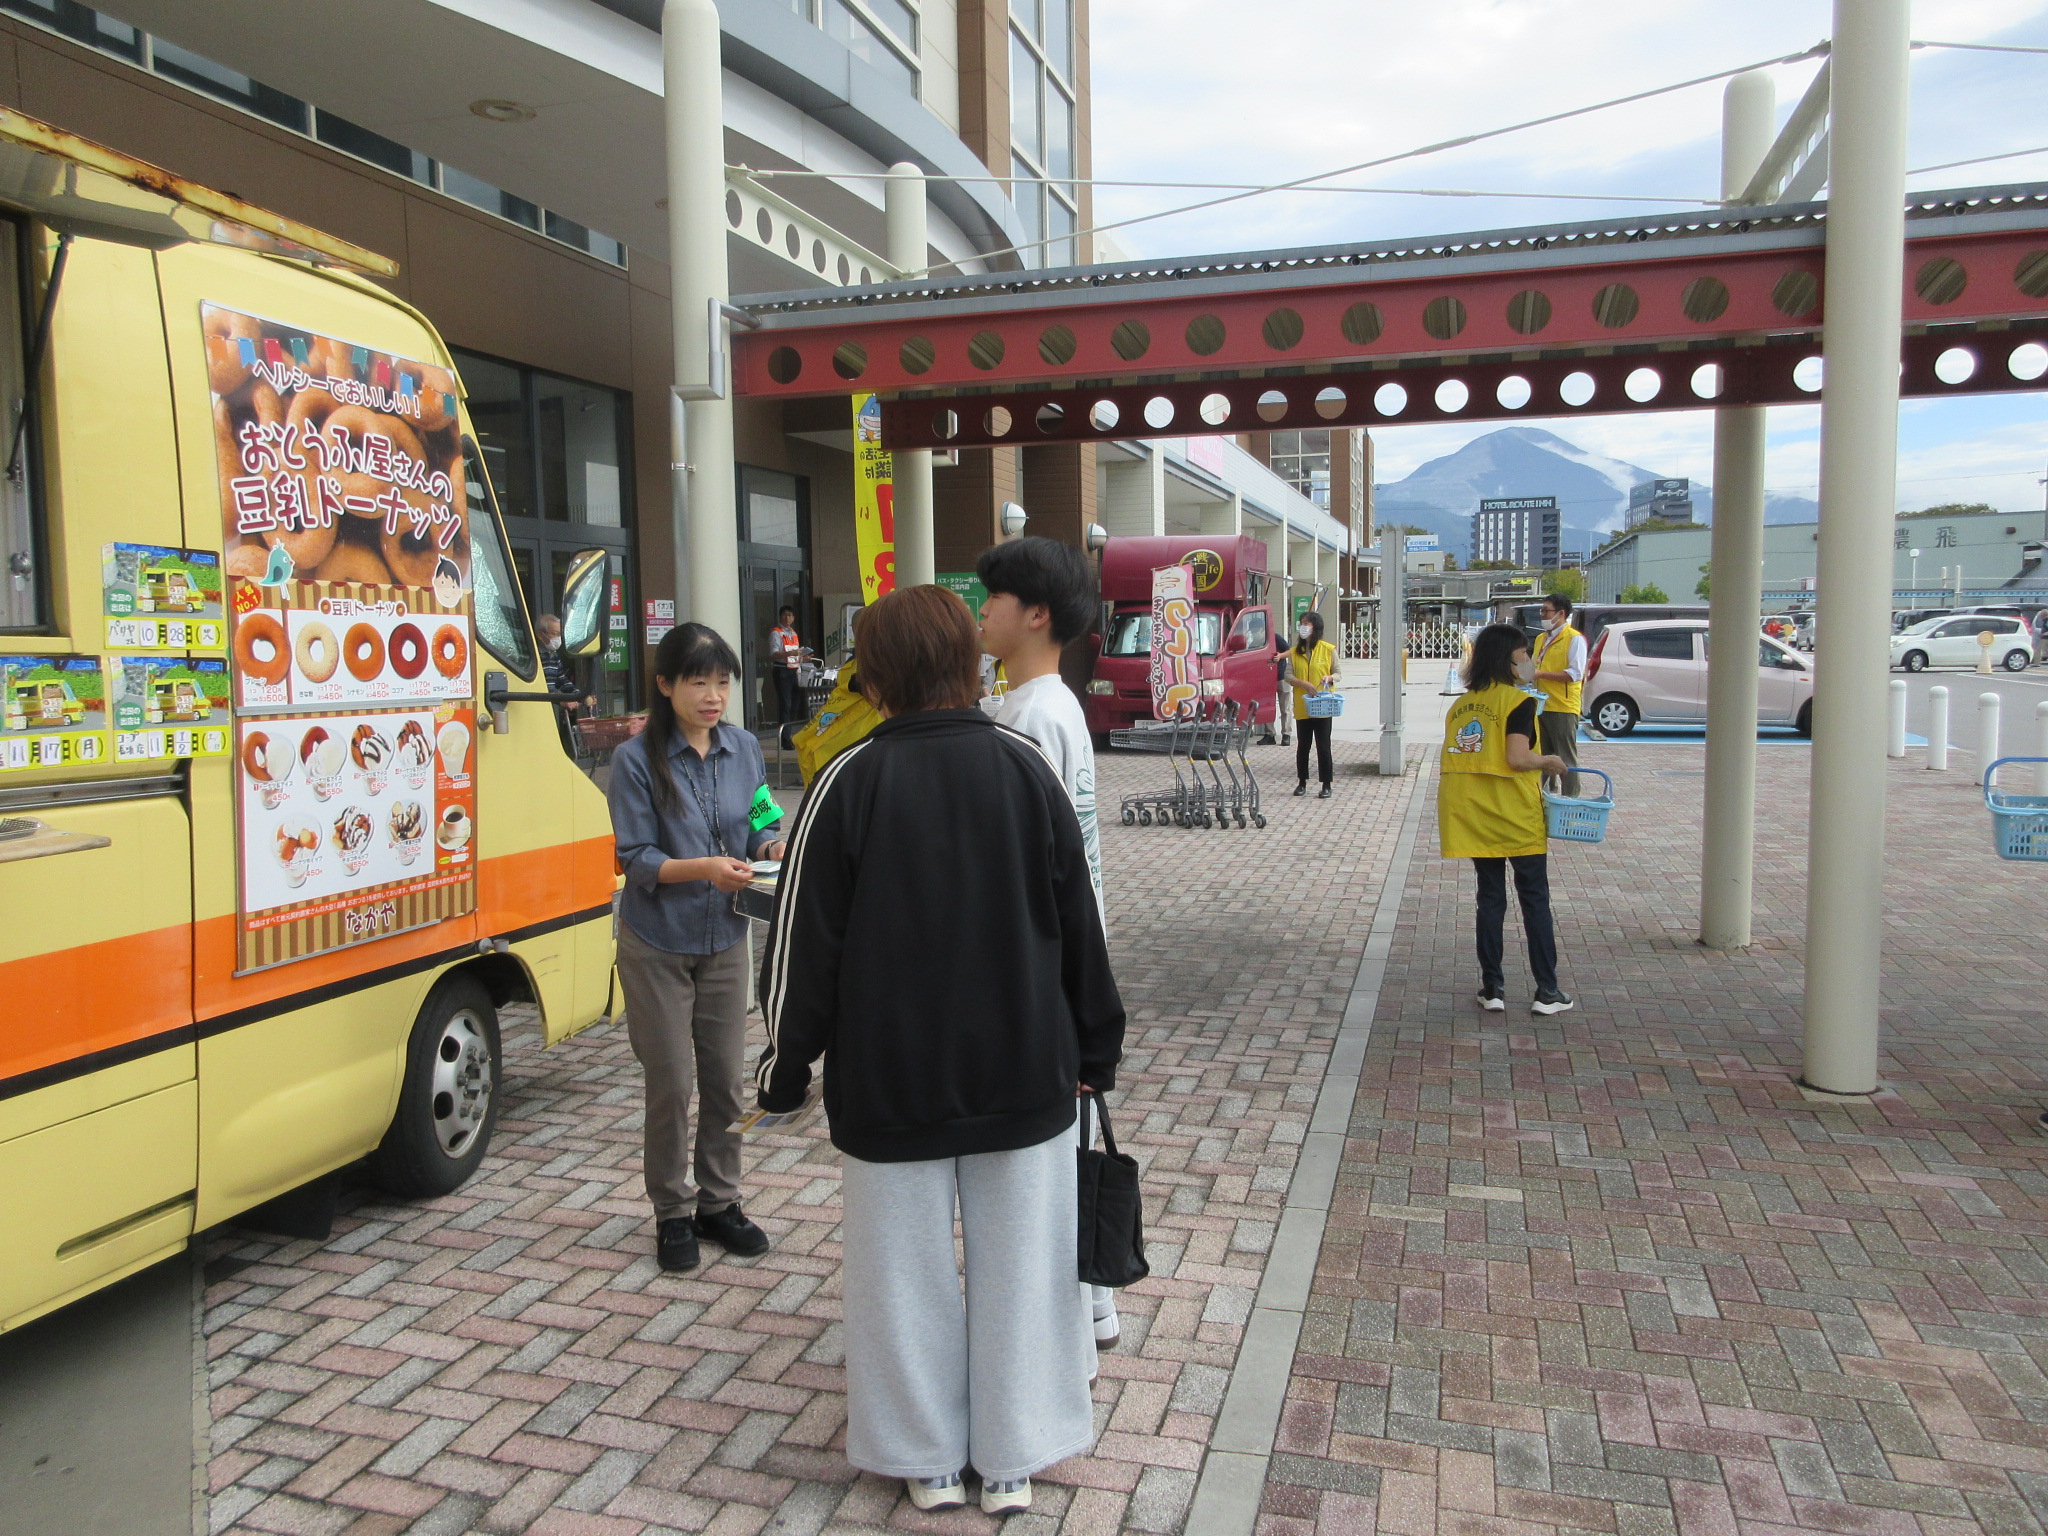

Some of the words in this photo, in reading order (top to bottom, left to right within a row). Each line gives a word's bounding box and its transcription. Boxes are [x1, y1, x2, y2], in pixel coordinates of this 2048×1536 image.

[253, 359, 421, 418] ヘルシーでおいしい!
[240, 418, 453, 503] おとうふ屋さんの
[231, 471, 461, 549] 豆乳ドーナッツ
[1484, 501, 1508, 510] HOTEL
[1509, 500, 1535, 509] ROUTE
[1536, 499, 1552, 508] INN
[236, 595, 259, 614] NO.1
[332, 600, 395, 617] 豆乳ドーナツ
[749, 798, 771, 821] 地域
[346, 902, 396, 933] なかや
